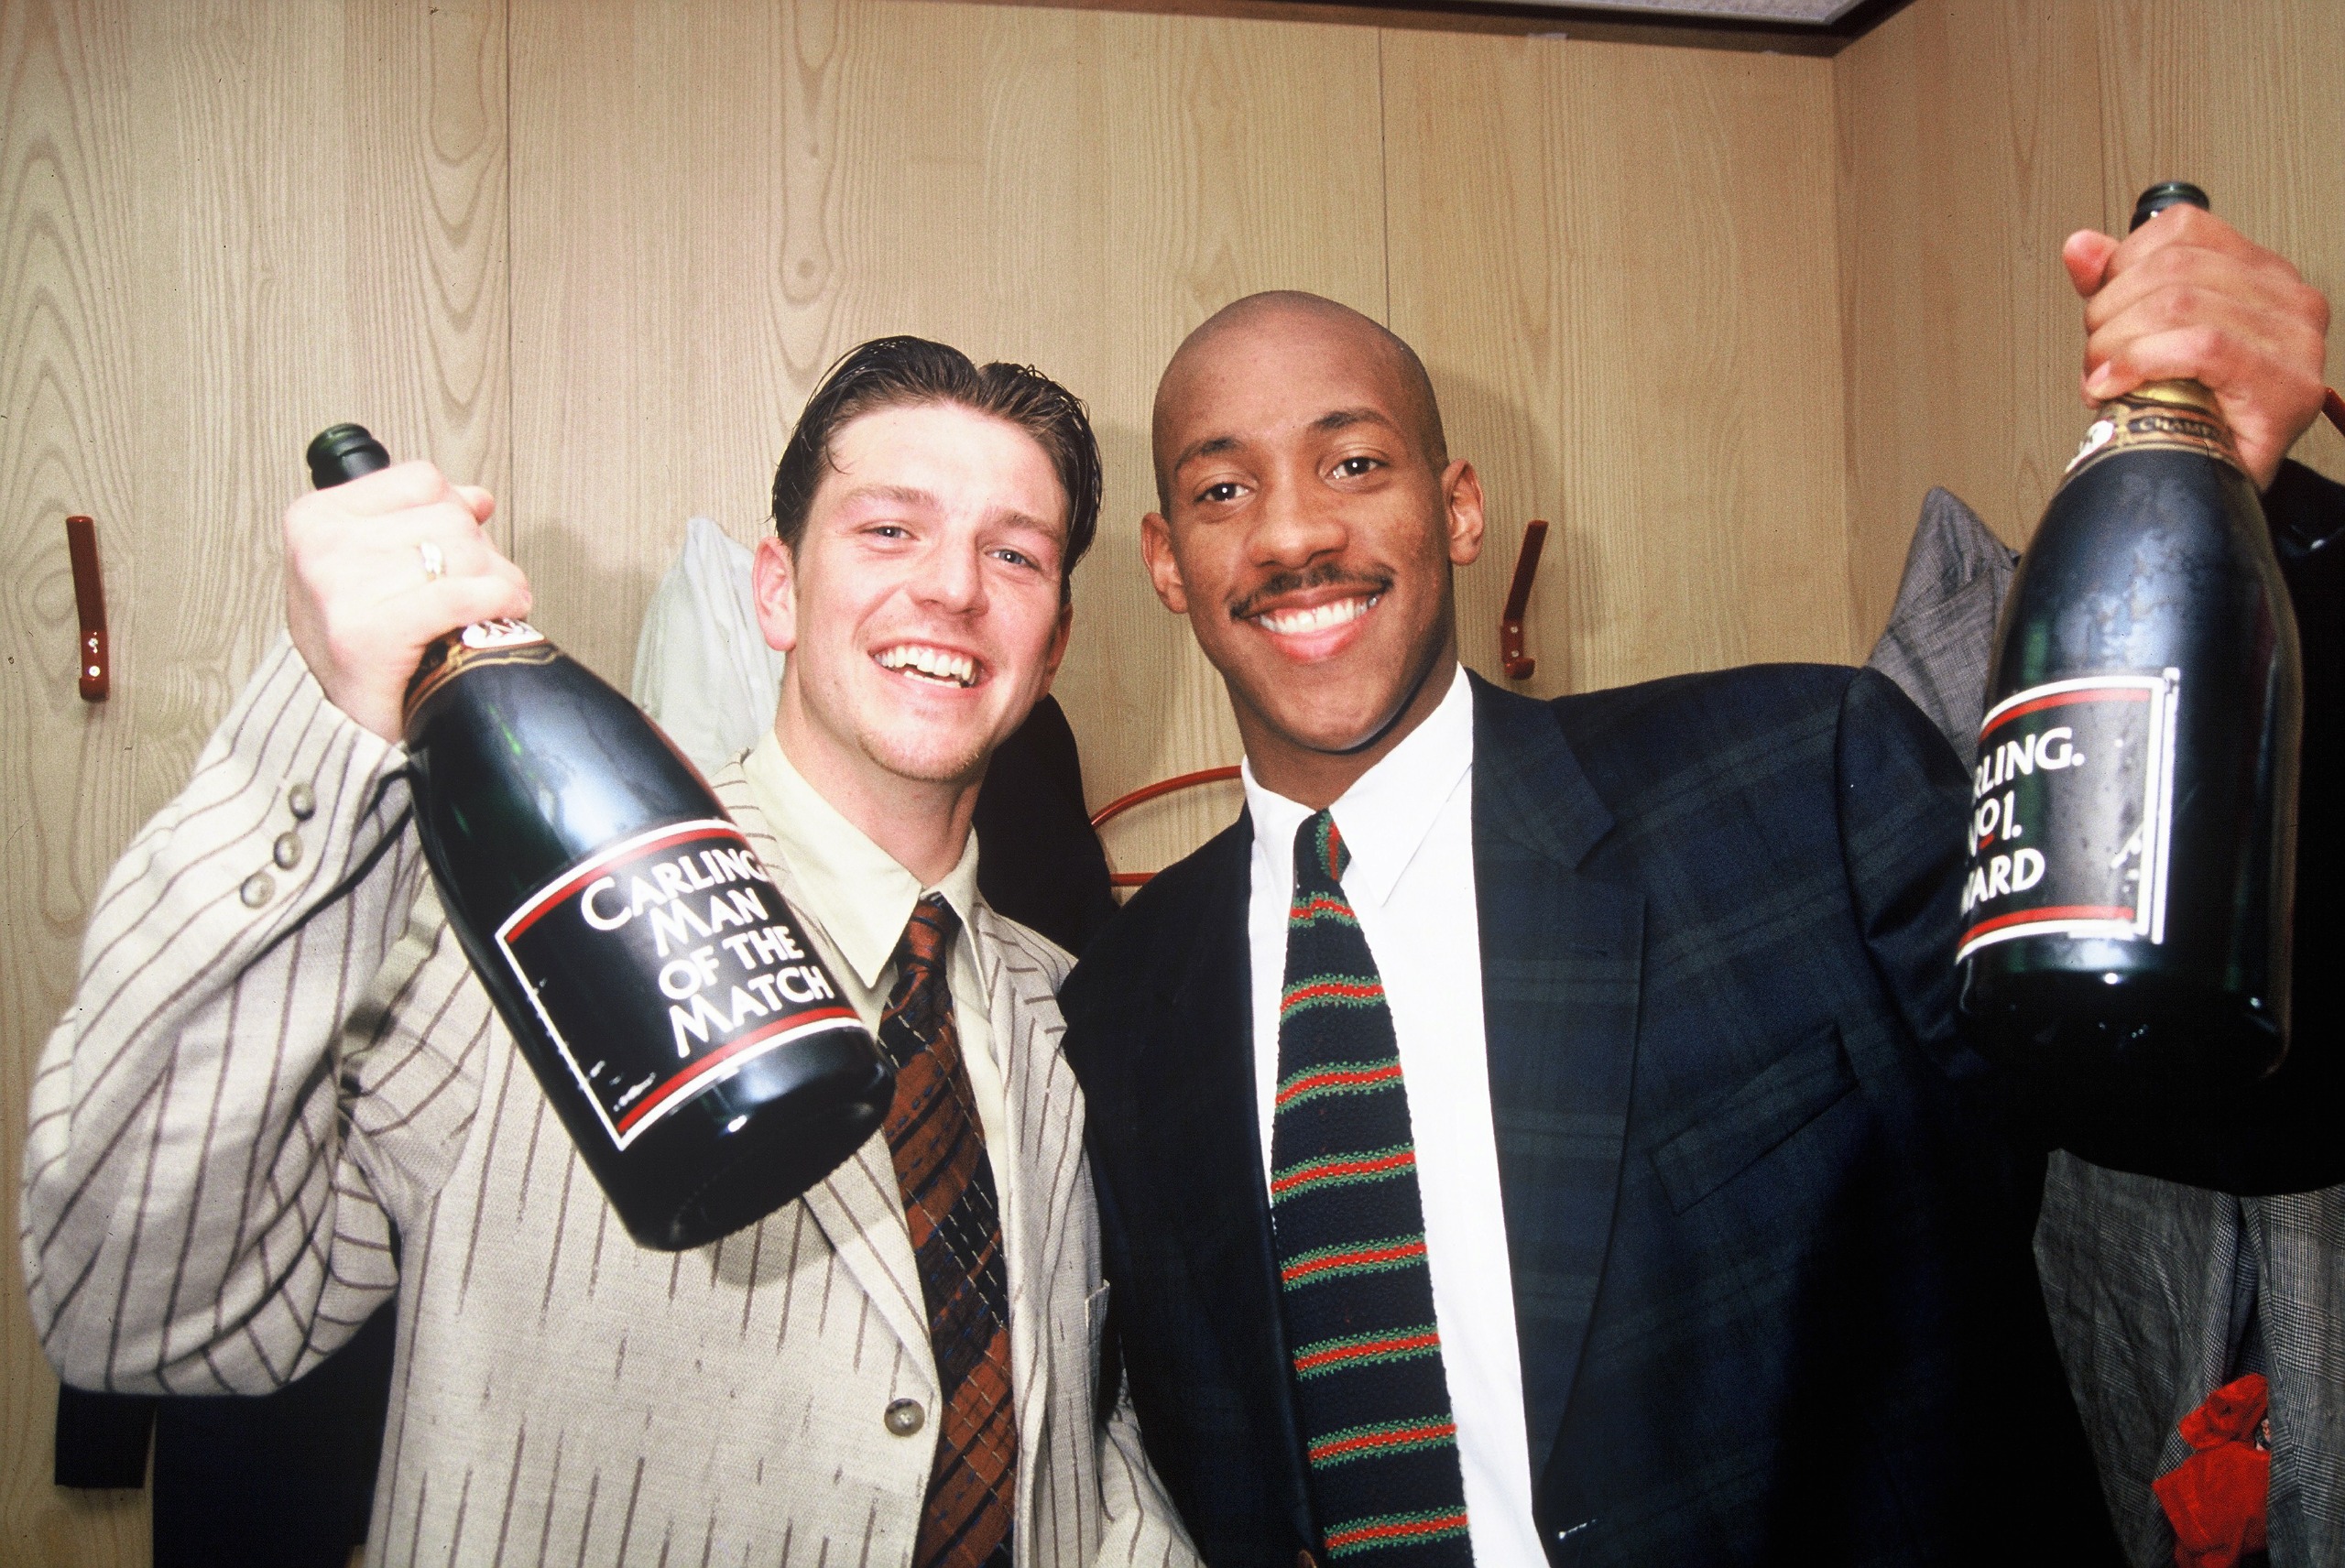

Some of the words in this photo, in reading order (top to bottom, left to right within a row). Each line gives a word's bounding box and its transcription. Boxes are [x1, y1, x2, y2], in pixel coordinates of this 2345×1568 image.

[580, 848, 769, 931] CARLING
[649, 887, 769, 958] MAN
[658, 945, 720, 1001] OF
[722, 925, 805, 971] THE
[668, 964, 835, 1059] MATCH
